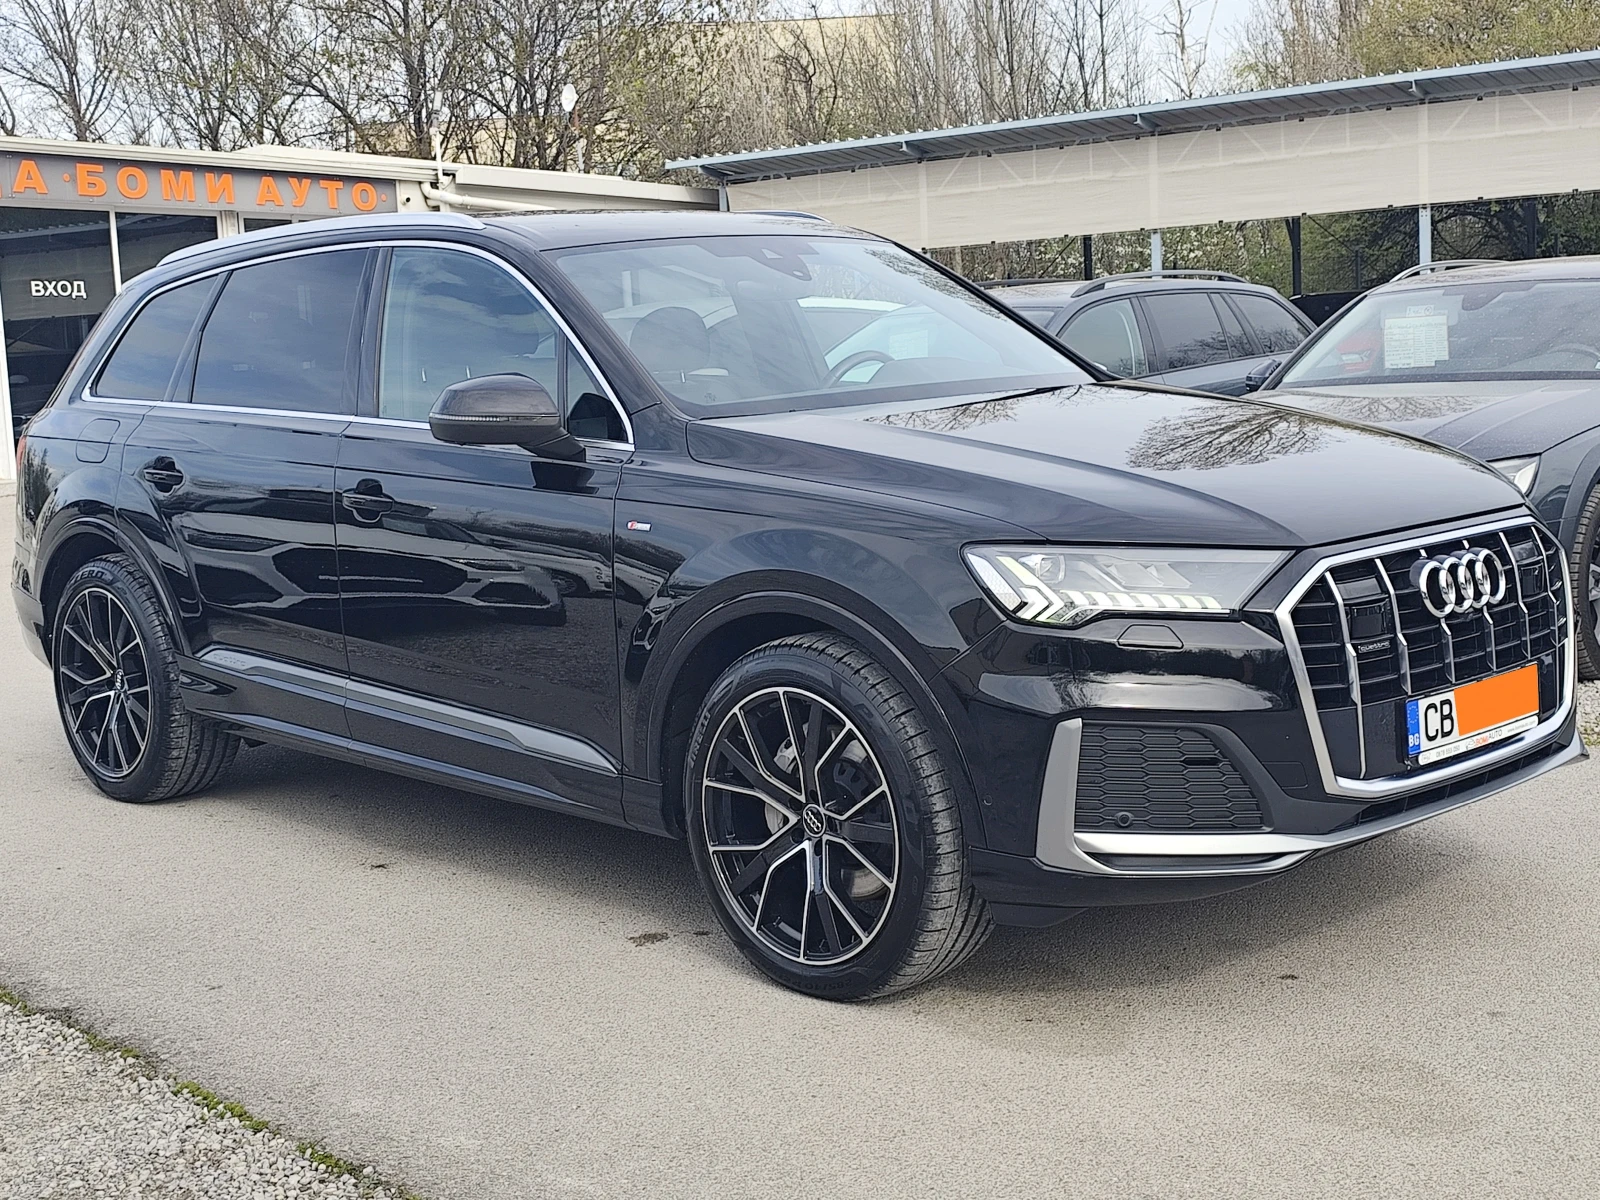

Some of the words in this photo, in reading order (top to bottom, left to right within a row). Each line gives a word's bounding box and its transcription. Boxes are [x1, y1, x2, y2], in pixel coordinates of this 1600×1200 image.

[30, 280, 87, 299] ВХОД
[1424, 698, 1455, 742] CB
[1408, 733, 1420, 747] BG
